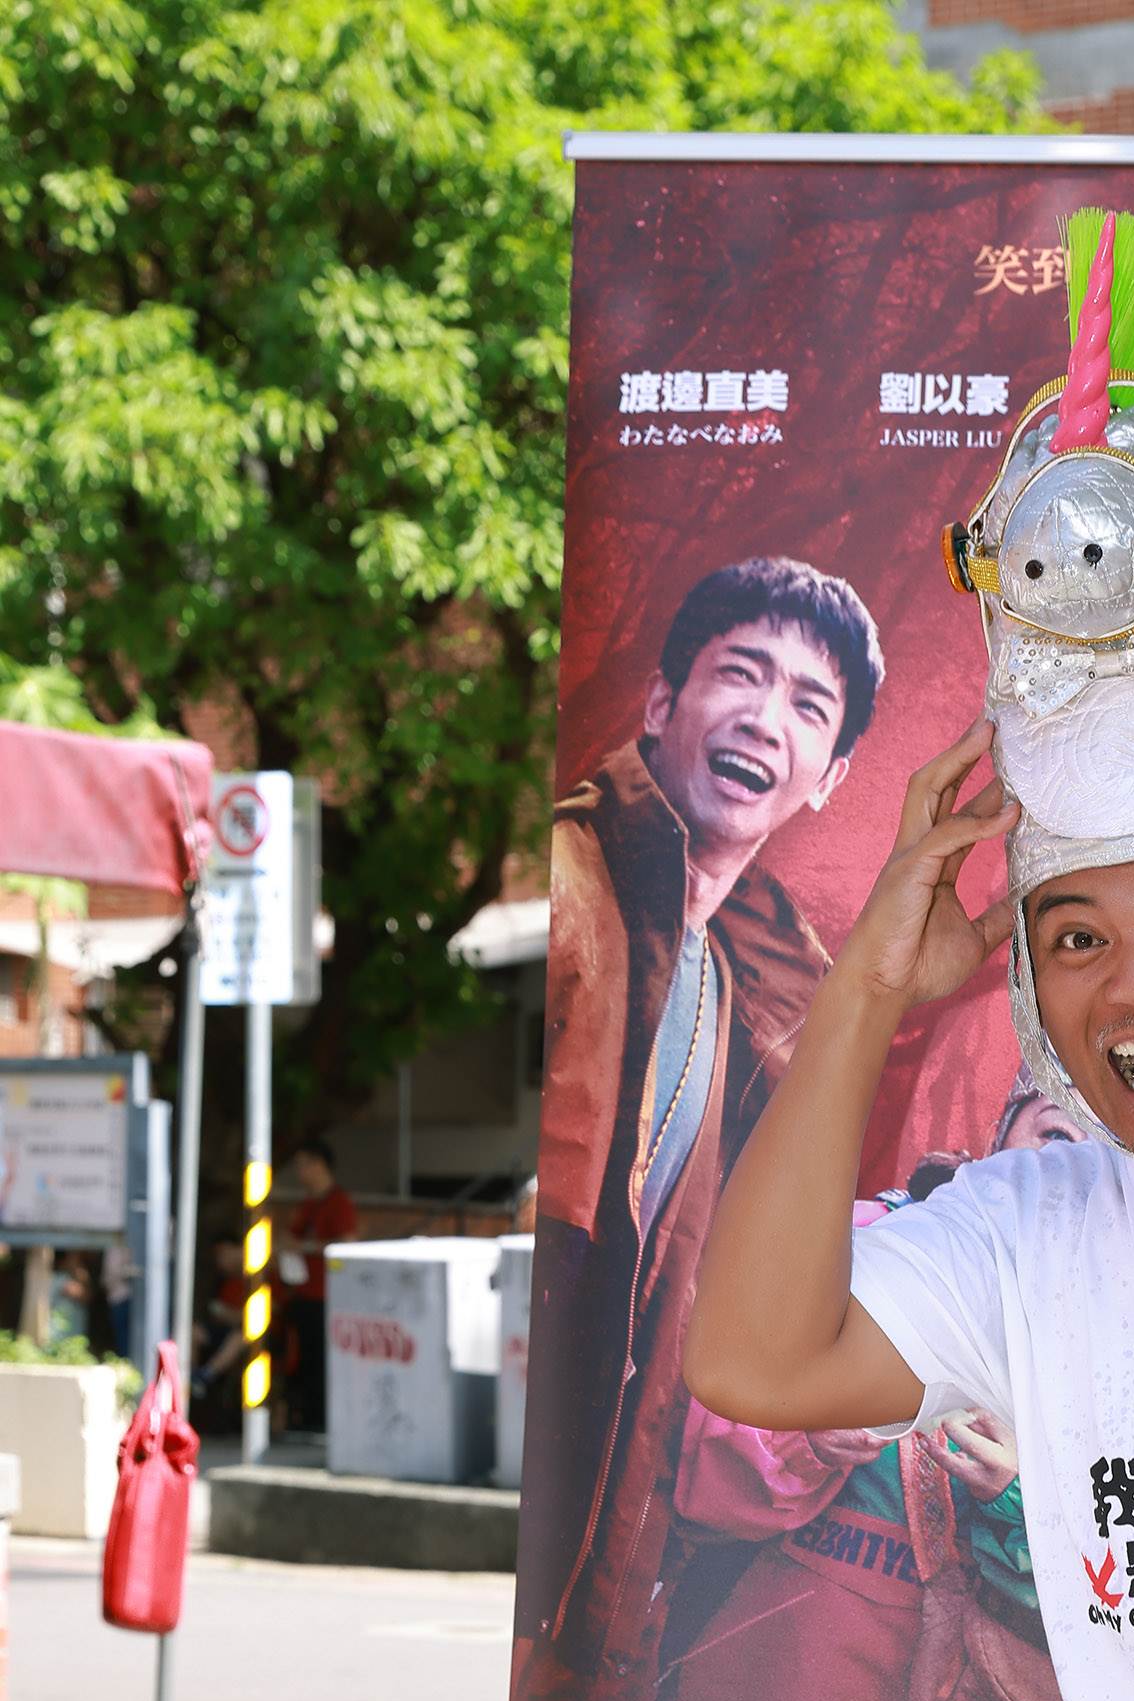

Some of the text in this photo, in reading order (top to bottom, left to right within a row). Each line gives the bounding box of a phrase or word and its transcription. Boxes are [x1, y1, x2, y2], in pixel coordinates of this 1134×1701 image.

[618, 369, 789, 414] 渡邊直美
[878, 371, 1010, 417] 劉以豪
[618, 422, 784, 447] わたなべなおみ
[879, 428, 1002, 450] JASPER LIU
